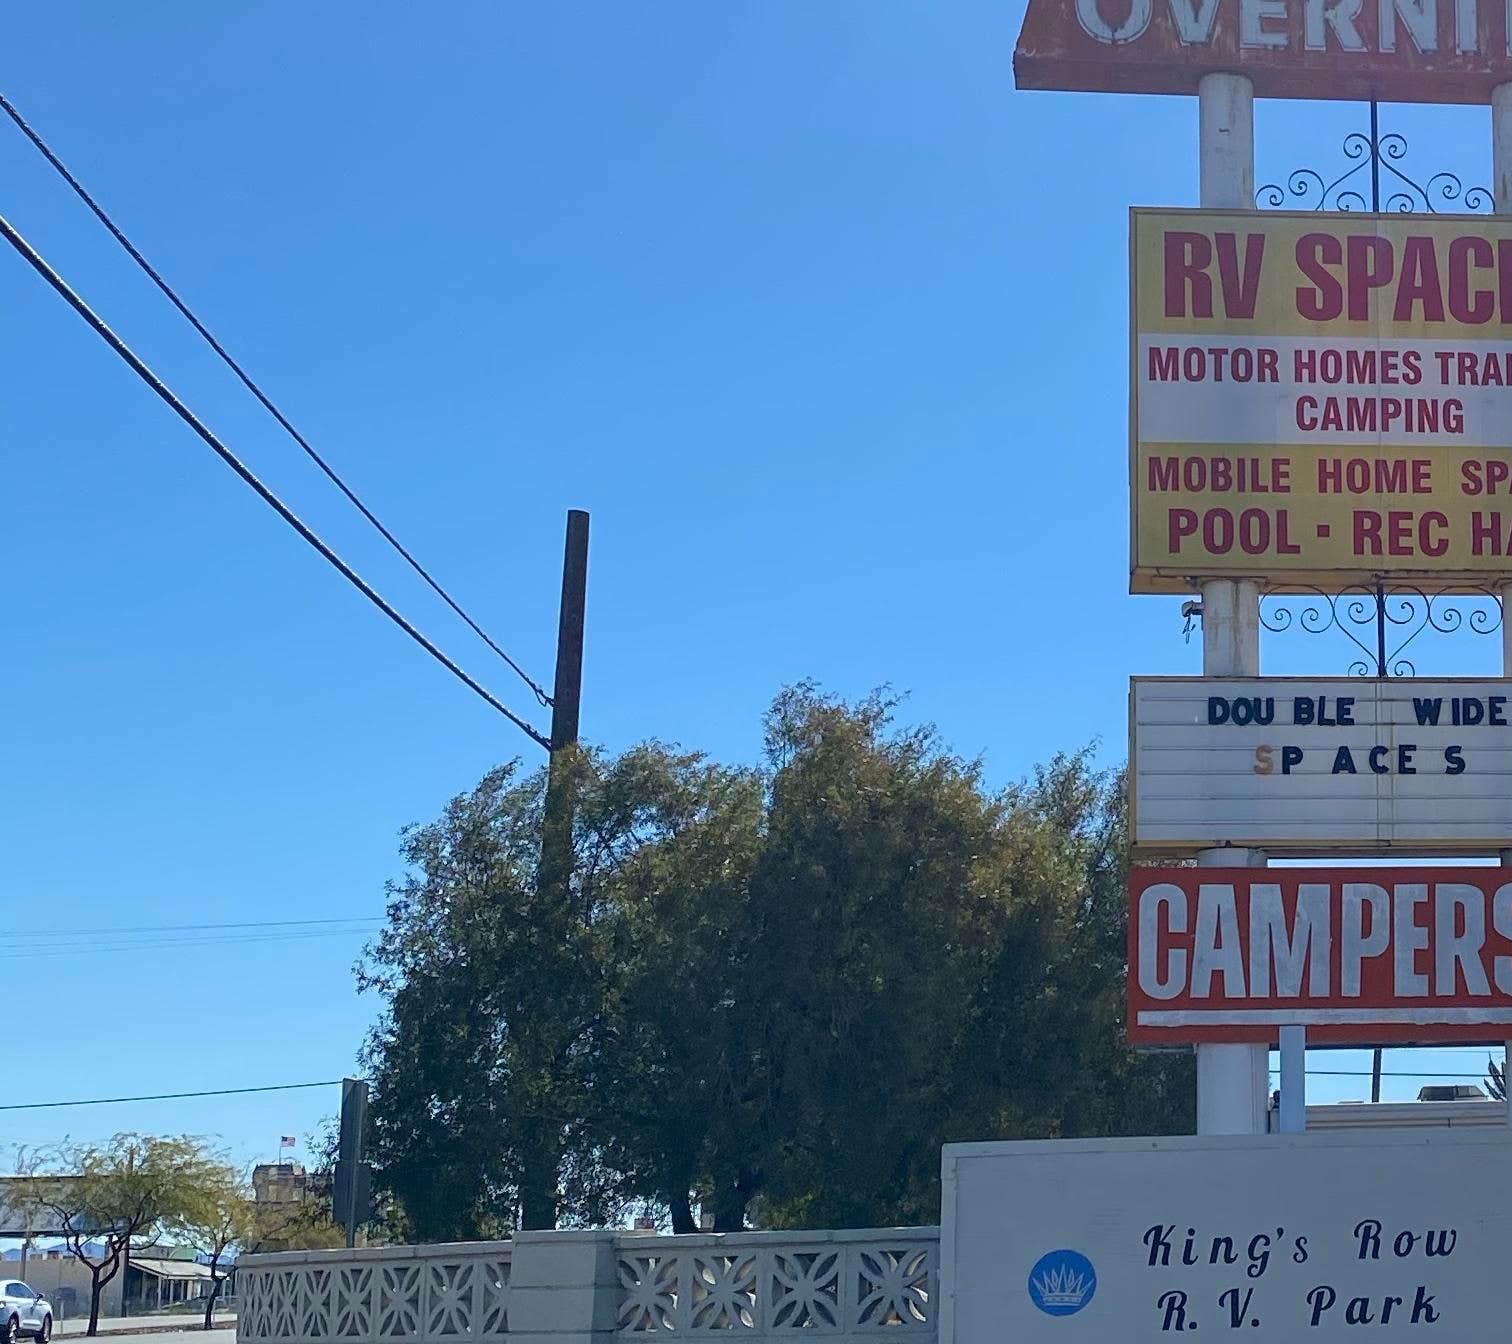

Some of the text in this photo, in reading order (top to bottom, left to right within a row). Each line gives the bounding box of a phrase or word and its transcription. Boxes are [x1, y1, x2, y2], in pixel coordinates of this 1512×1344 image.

[1163, 231, 1266, 320] RV
[1148, 346, 1280, 384] MOTOR
[1294, 348, 1423, 388] HOMES
[1295, 395, 1466, 435] CAMPING
[1148, 456, 1292, 494] MOBILE
[1317, 457, 1433, 496] HOME
[1169, 507, 1302, 556] POOL
[1352, 510, 1450, 558] REC
[1412, 696, 1509, 727] WIDE
[1143, 1218, 1459, 1278] King's Row
[1306, 1285, 1442, 1328] Park
